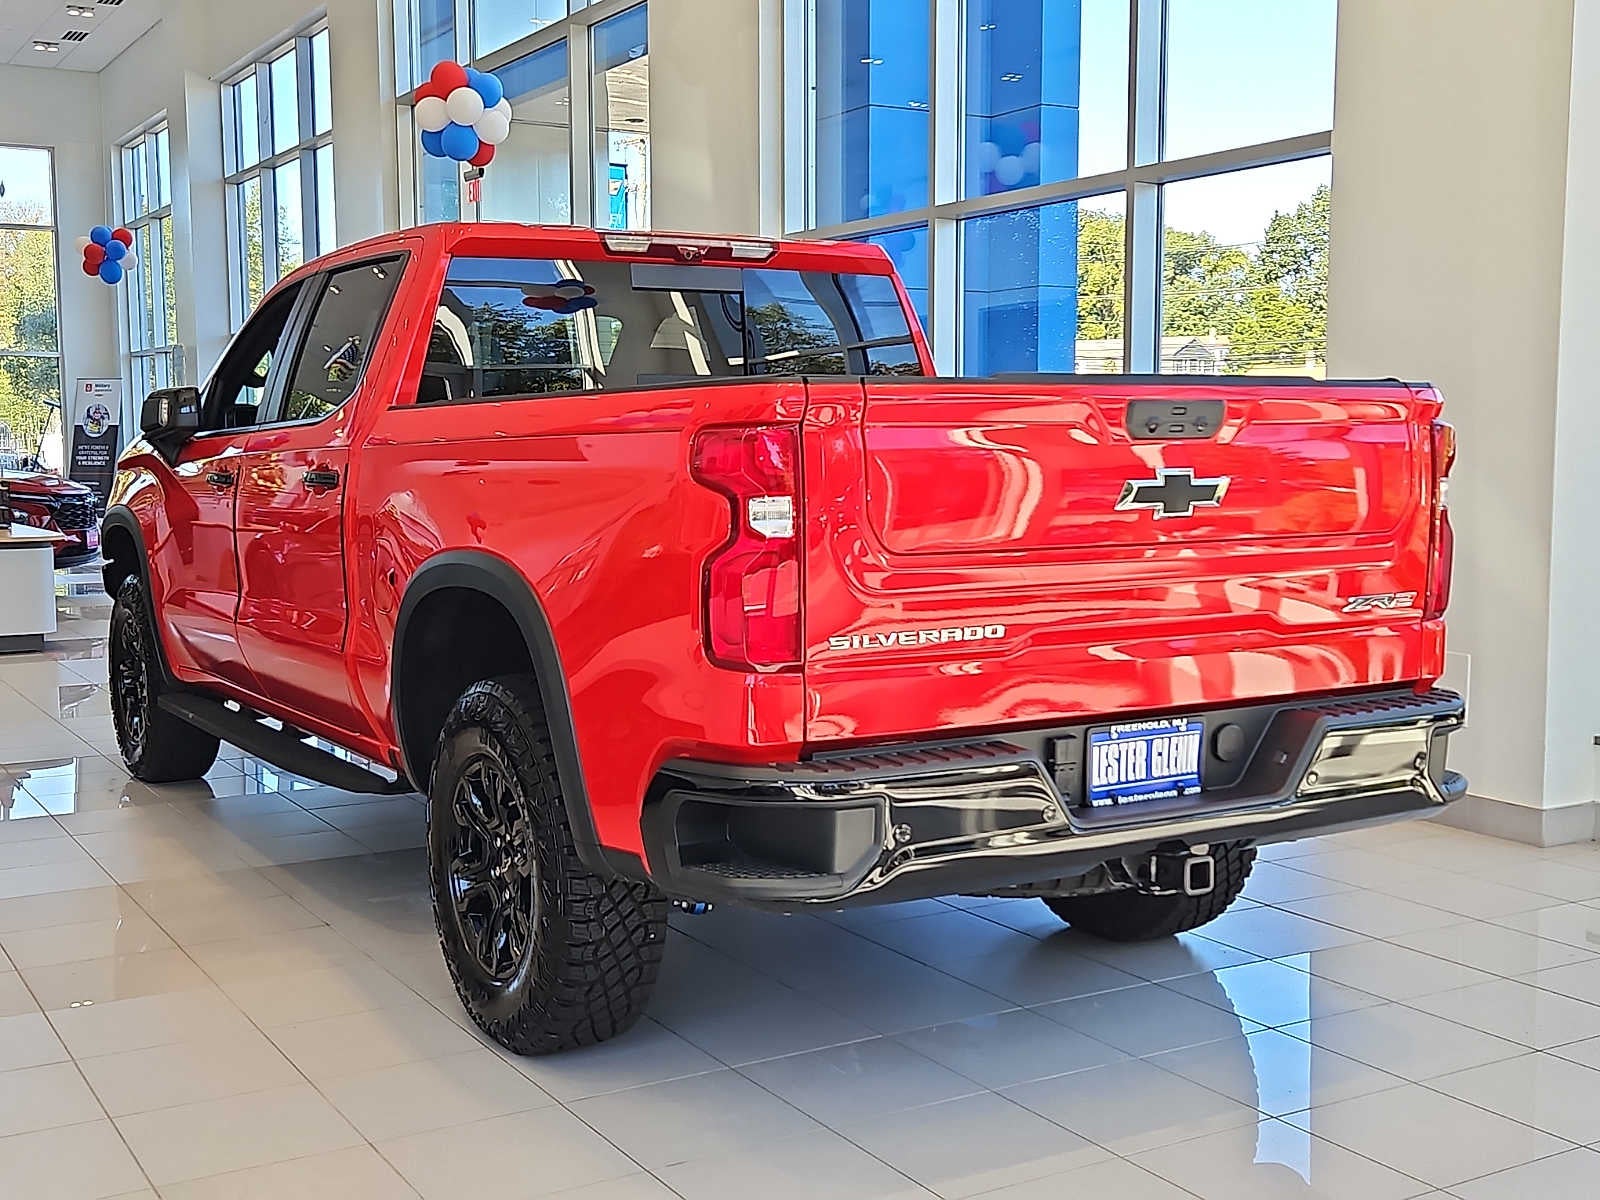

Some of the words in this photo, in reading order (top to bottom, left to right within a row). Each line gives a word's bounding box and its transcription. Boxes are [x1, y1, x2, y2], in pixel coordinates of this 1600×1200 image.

[828, 623, 1007, 651] SILVERADO
[1092, 740, 1147, 786] LESTER
[1151, 734, 1200, 778] GLENN
